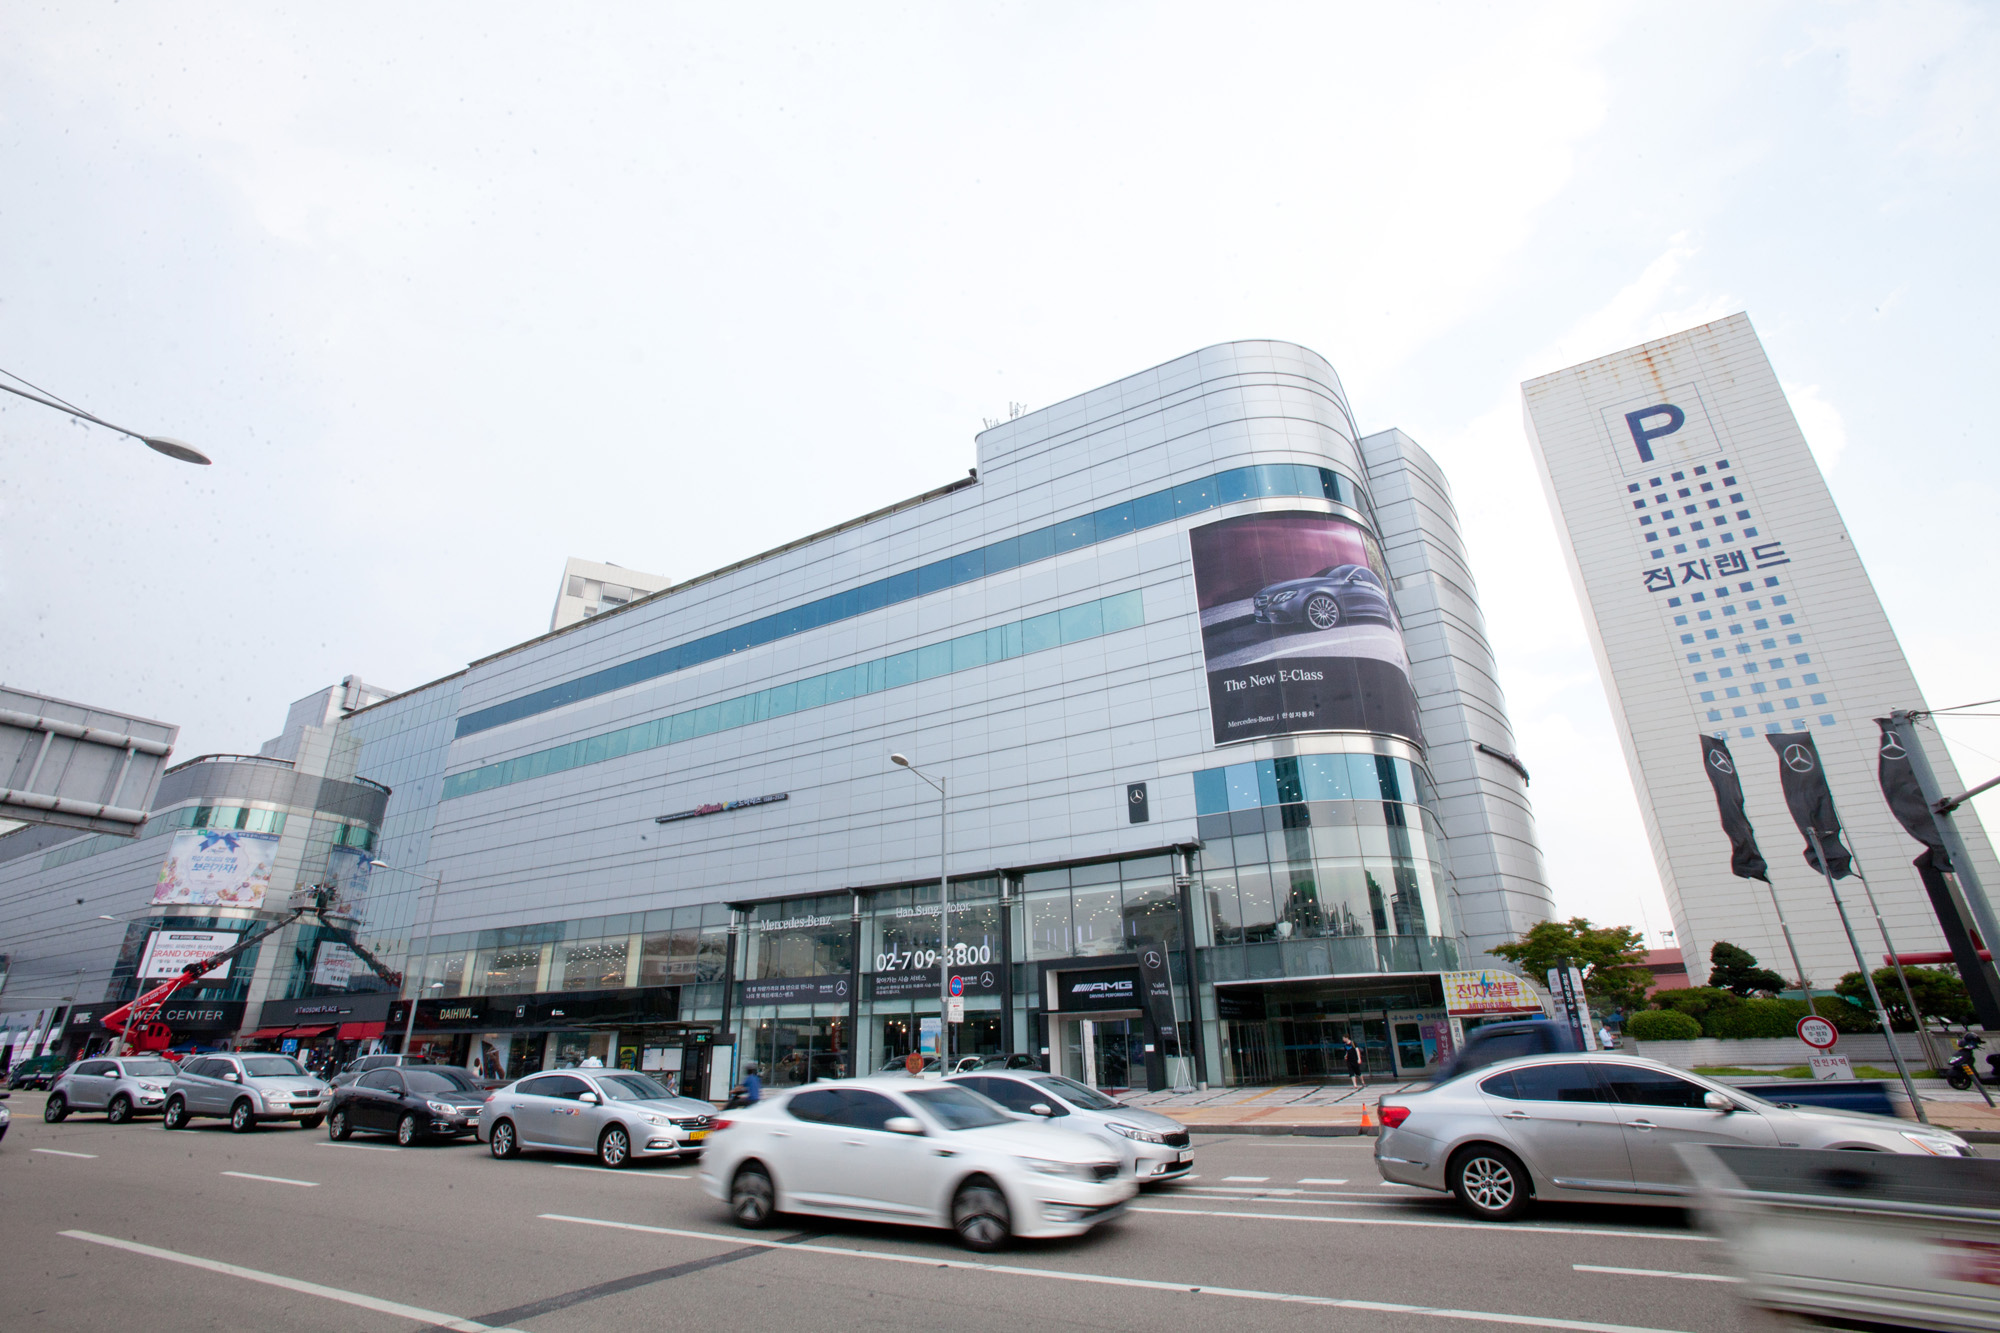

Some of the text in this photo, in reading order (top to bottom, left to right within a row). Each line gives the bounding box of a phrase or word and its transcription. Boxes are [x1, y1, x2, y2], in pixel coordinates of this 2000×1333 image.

[1624, 403, 1685, 463] P
[1642, 541, 1791, 593] 전자랜드
[1224, 669, 1324, 692] The New E-Class
[1227, 715, 1274, 728] Mercedes-Benz
[191, 862, 239, 874] 보러가자!
[896, 906, 914, 918] Han
[915, 905, 939, 917] Sung
[760, 914, 832, 931] Mercedes-Benz
[183, 950, 219, 958] OPENIN
[876, 945, 991, 972] 02-709-3800
[910, 974, 927, 982] 서비스
[1090, 981, 1133, 991] AMG
[166, 1010, 224, 1021] CENTER
[299, 1006, 321, 1014] TWOSOME
[439, 1008, 472, 1020] DAIHWA
[1812, 1057, 1847, 1067] 견인지역
